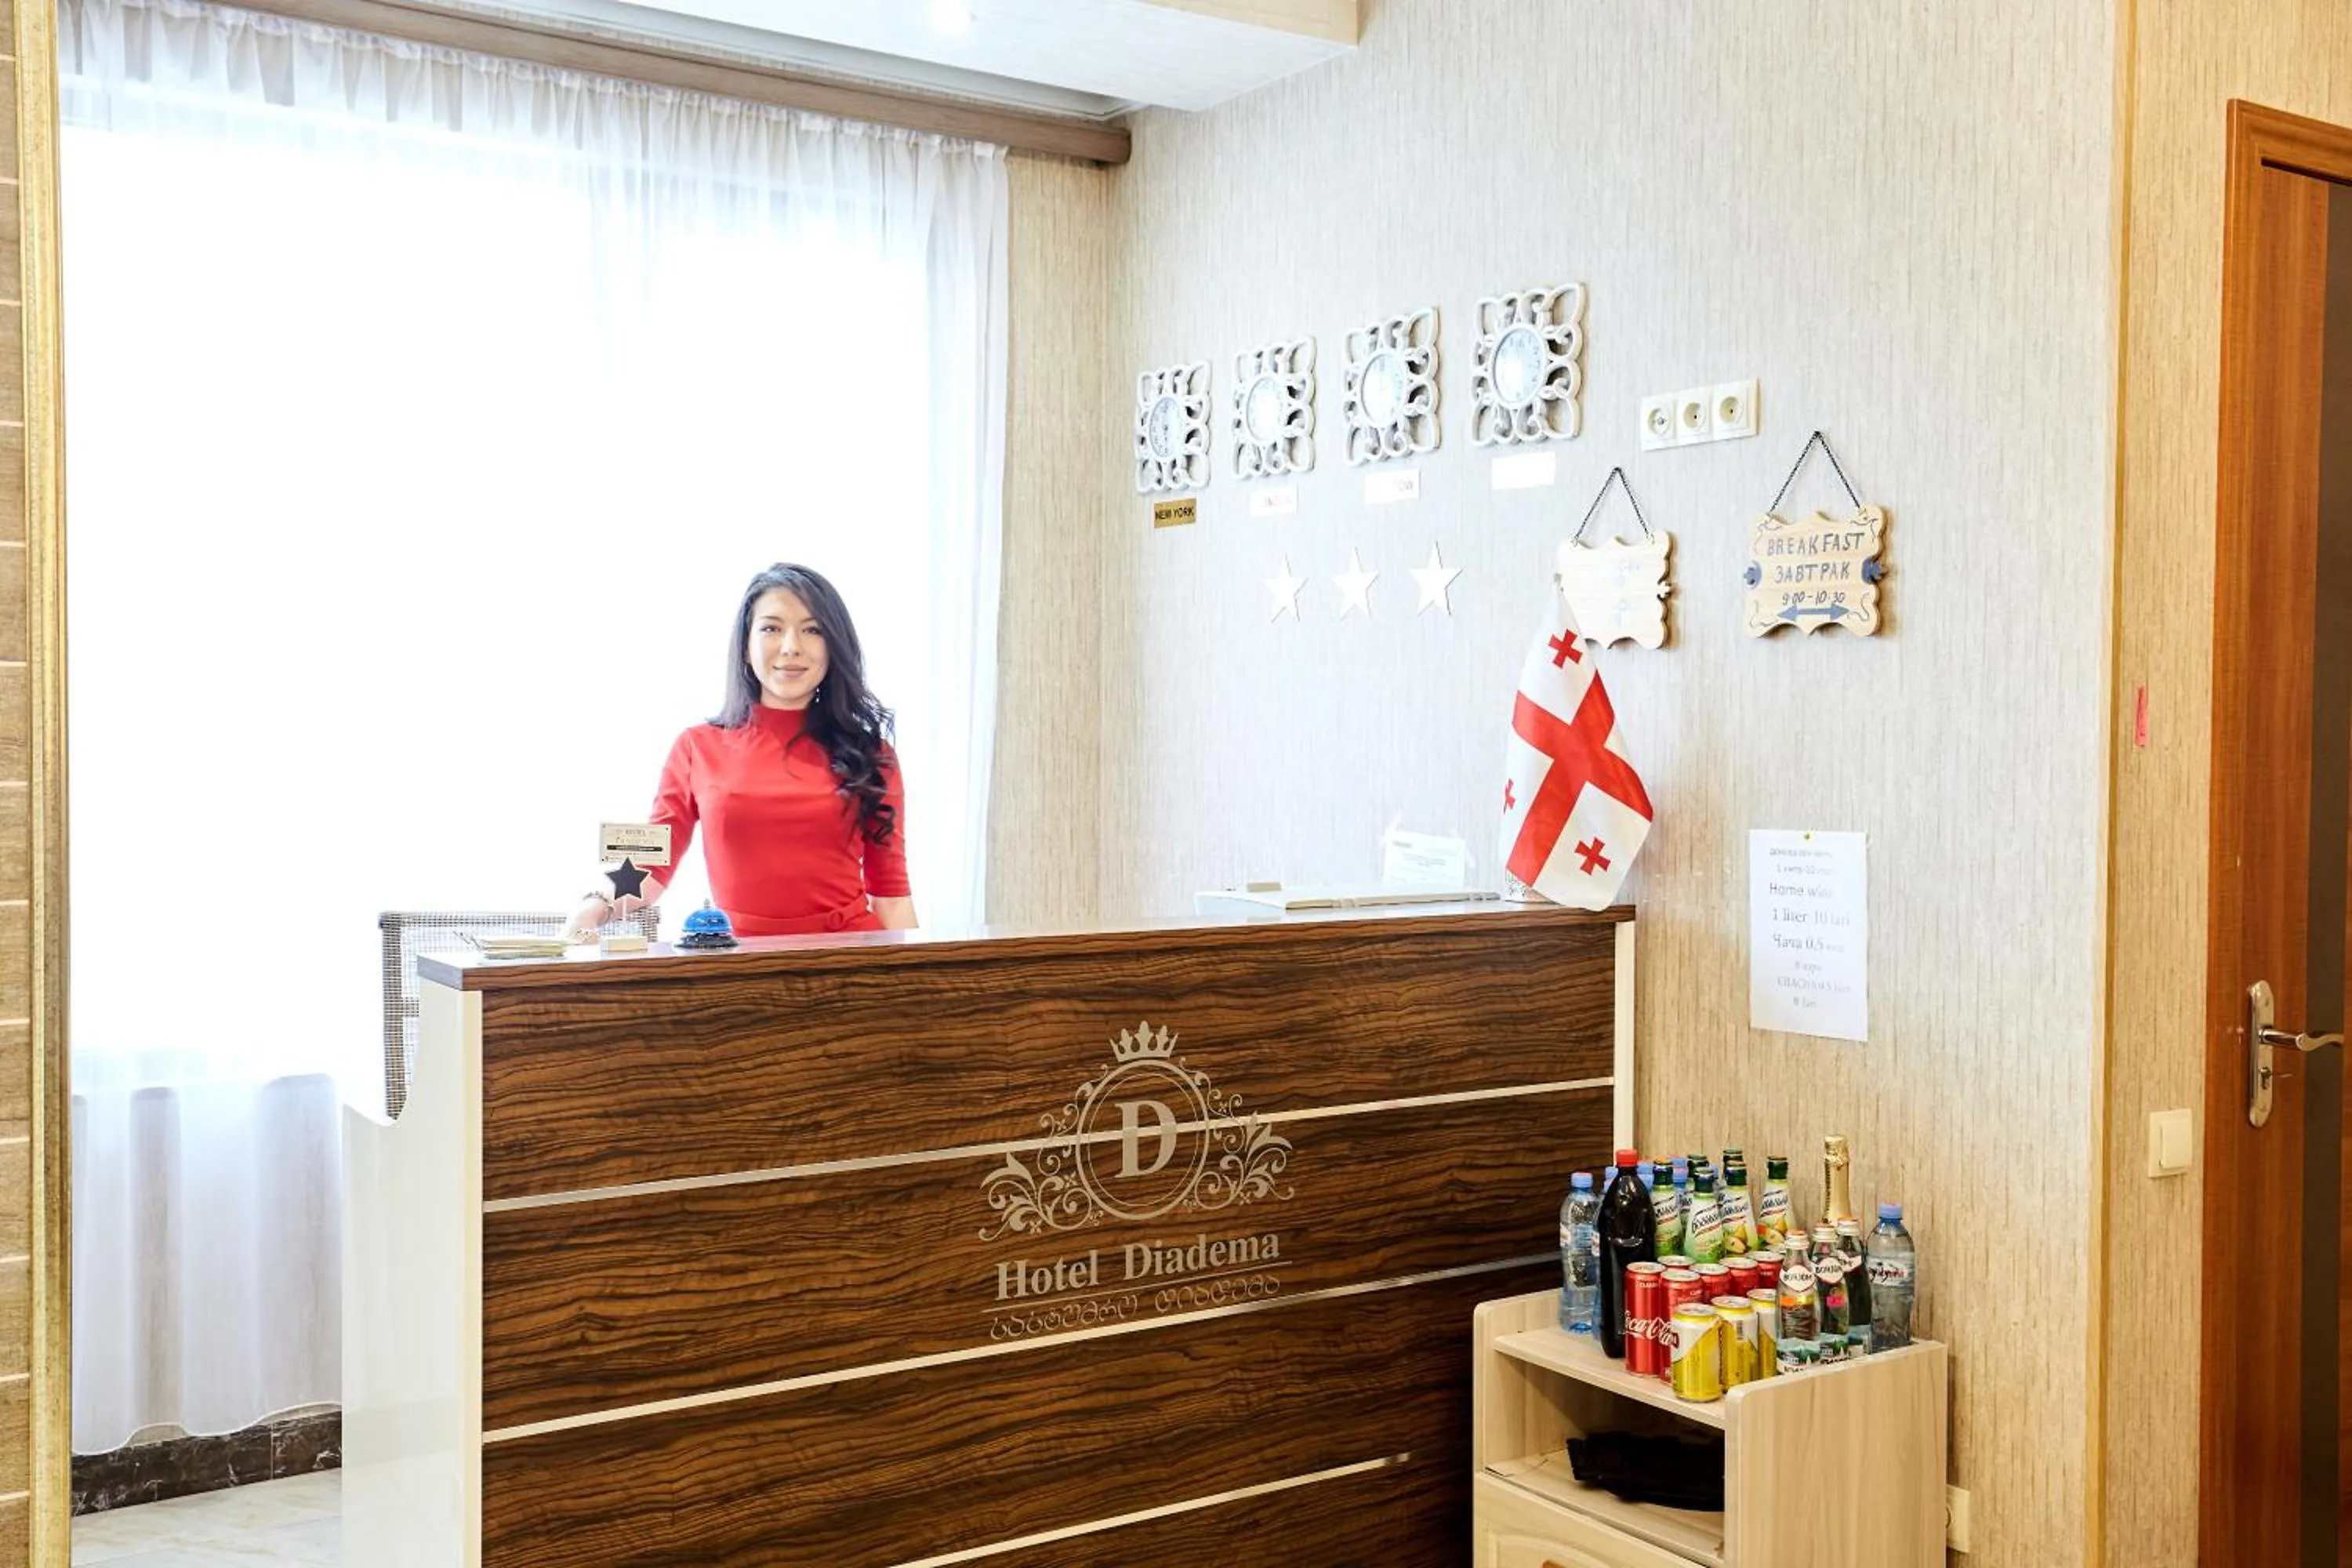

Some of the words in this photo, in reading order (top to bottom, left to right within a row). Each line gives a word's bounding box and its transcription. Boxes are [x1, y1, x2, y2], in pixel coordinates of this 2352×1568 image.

[1155, 508, 1172, 521] NEW
[1173, 506, 1194, 518] YORK
[1766, 532, 1865, 557] BREAKFAST
[1773, 561, 1851, 584] ЗАВТРАК
[1769, 882, 1804, 896] Home
[1114, 1100, 1177, 1178] D
[994, 1249, 1099, 1301] Hotel
[1123, 1233, 1280, 1280] Diadema
[990, 1294, 1138, 1340] სასტუმრო
[1154, 1274, 1281, 1313] დიადემა
